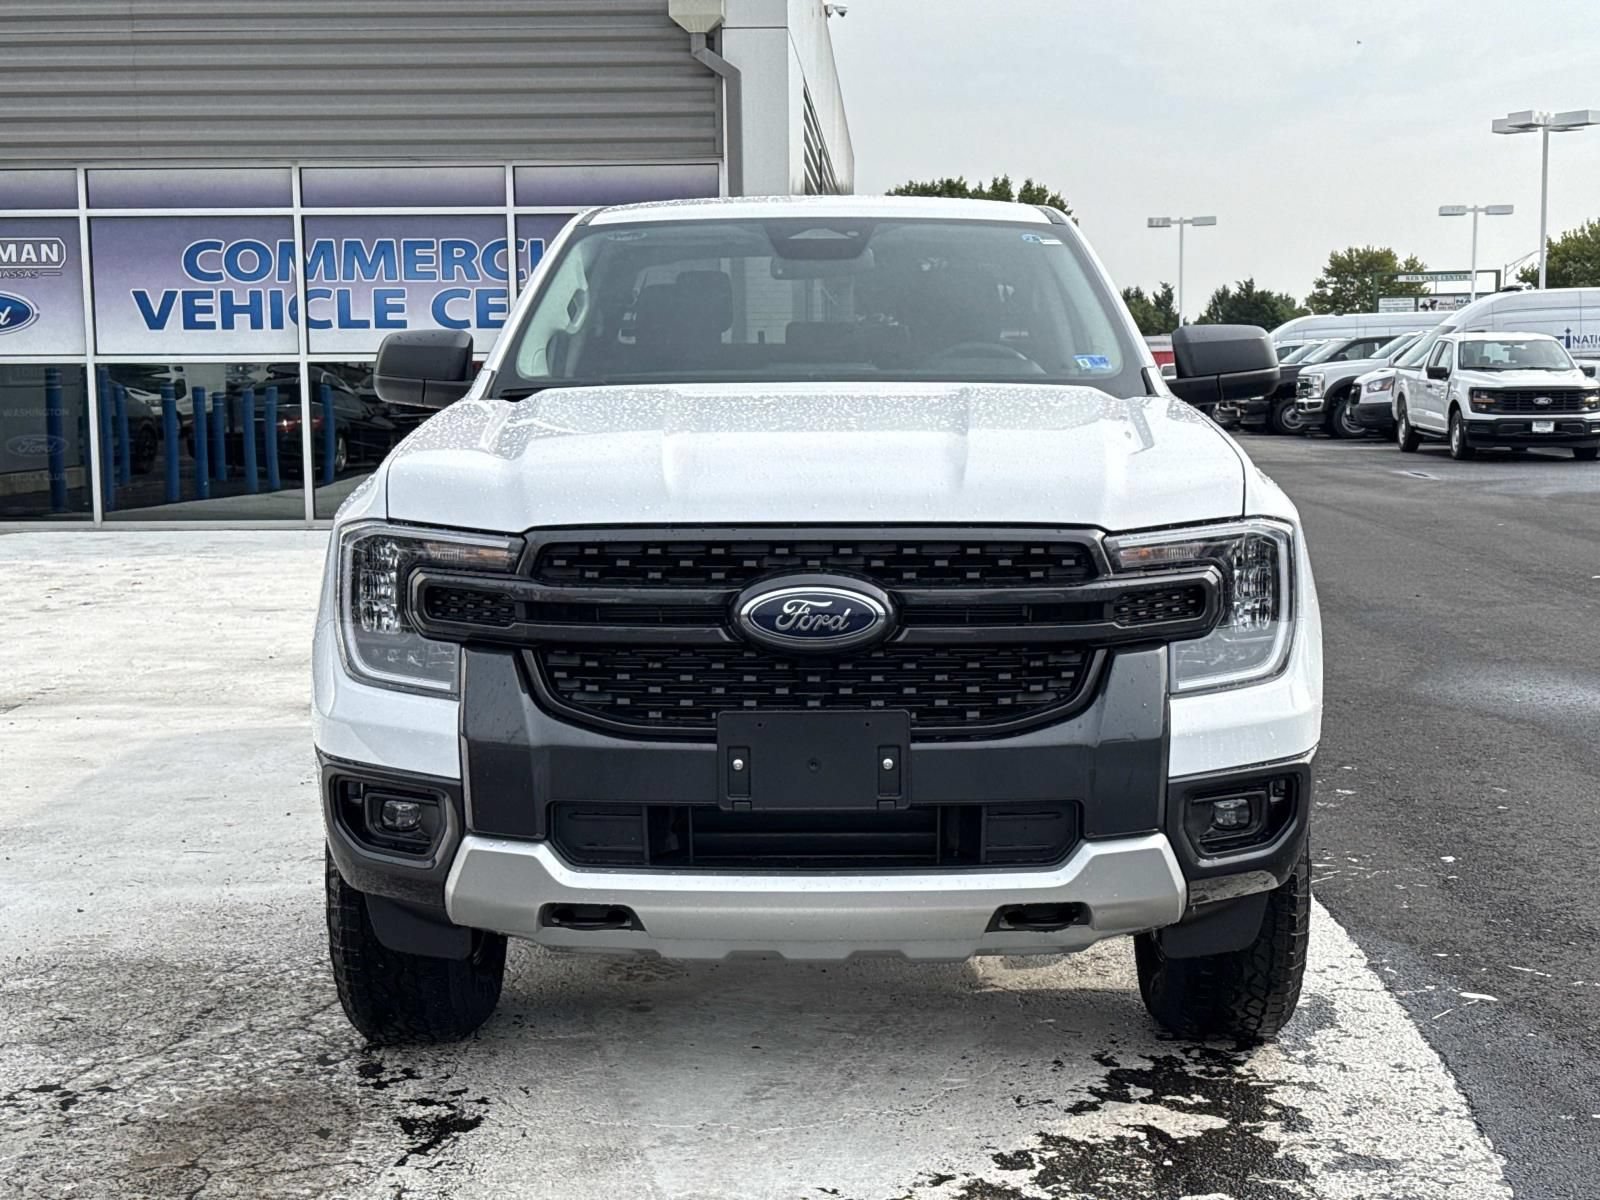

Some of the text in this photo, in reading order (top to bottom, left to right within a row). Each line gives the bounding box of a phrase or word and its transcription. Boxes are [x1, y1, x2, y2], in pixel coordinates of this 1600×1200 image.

[0, 270, 39, 279] ASSAS
[131, 288, 408, 331] VEHICLE
[1572, 335, 1600, 344] NATI
[3, 407, 70, 417] WASHINGTON
[17, 438, 57, 454] Ford
[775, 599, 852, 631] Ford
